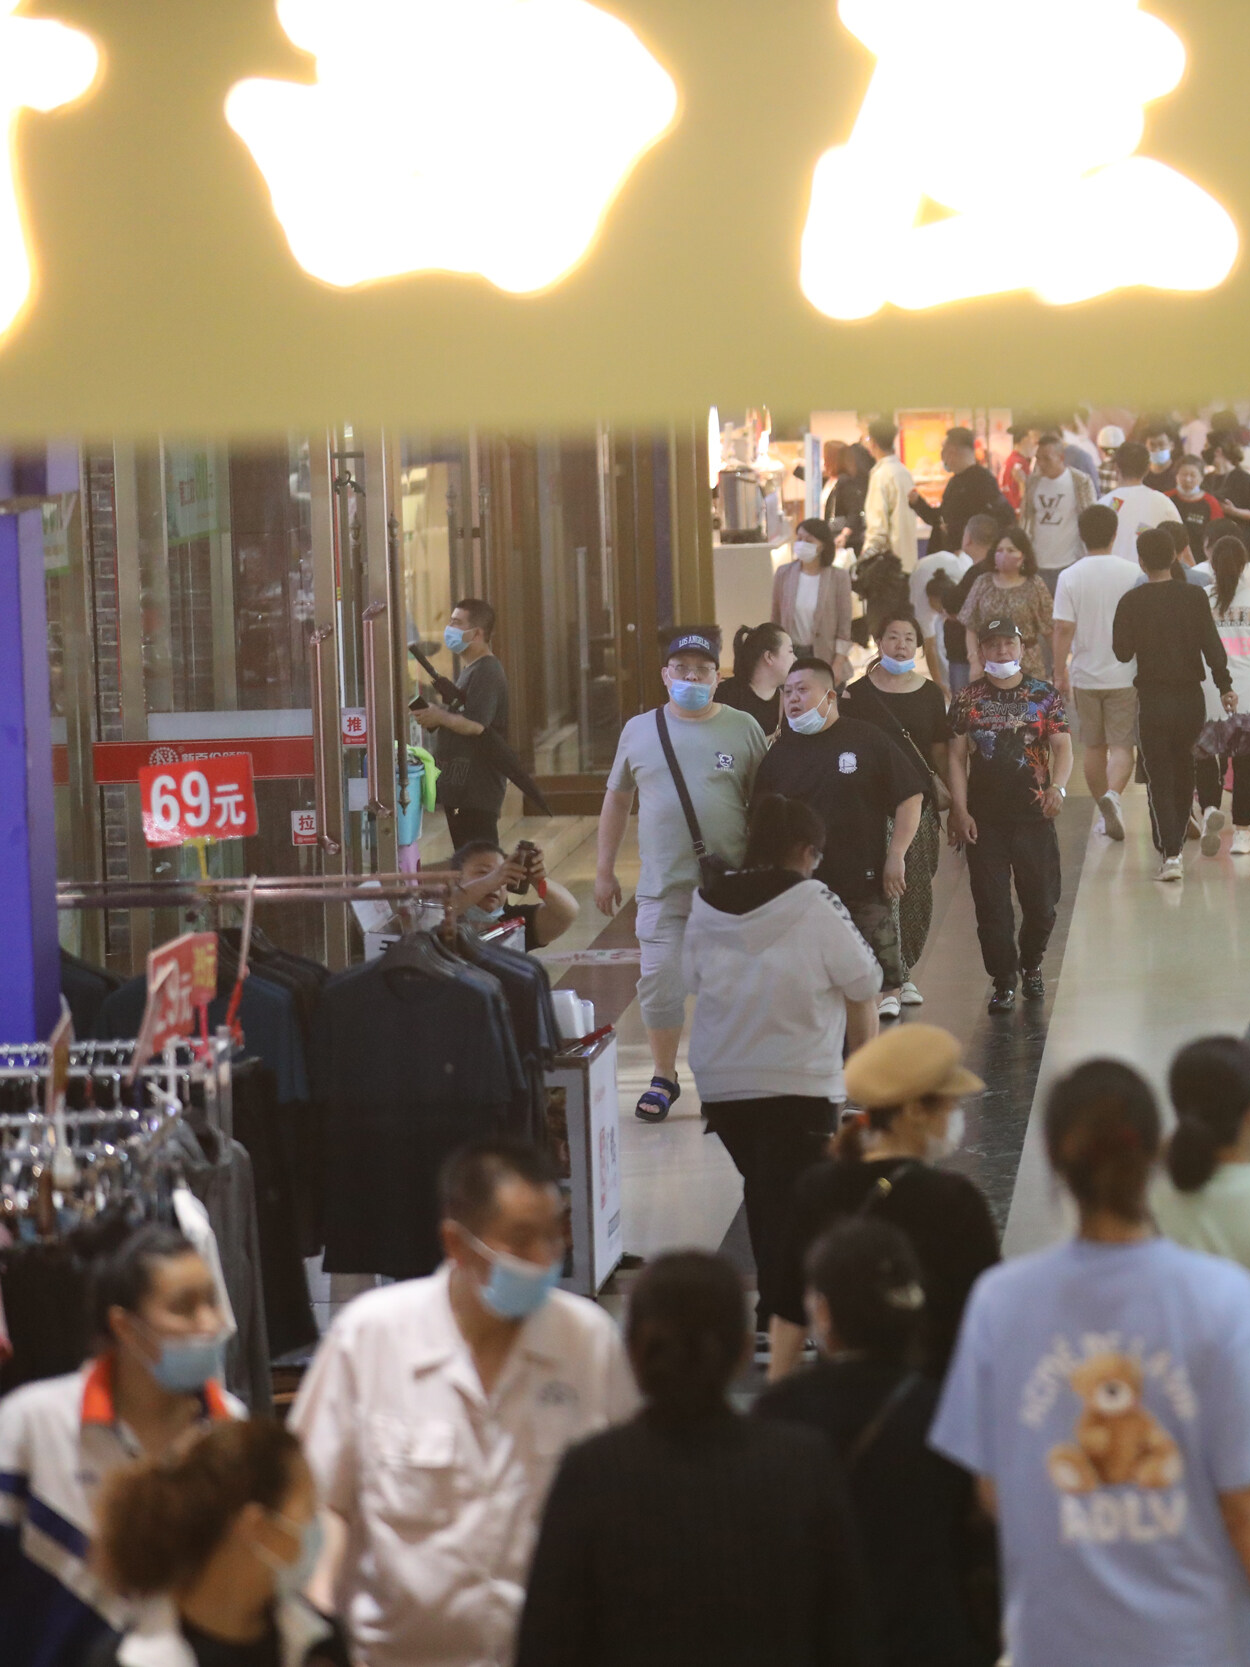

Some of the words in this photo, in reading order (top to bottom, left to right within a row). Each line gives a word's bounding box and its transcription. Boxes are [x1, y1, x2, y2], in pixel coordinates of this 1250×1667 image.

[347, 716, 362, 732] 推
[151, 770, 246, 831] 69元
[299, 815, 315, 831] 拉
